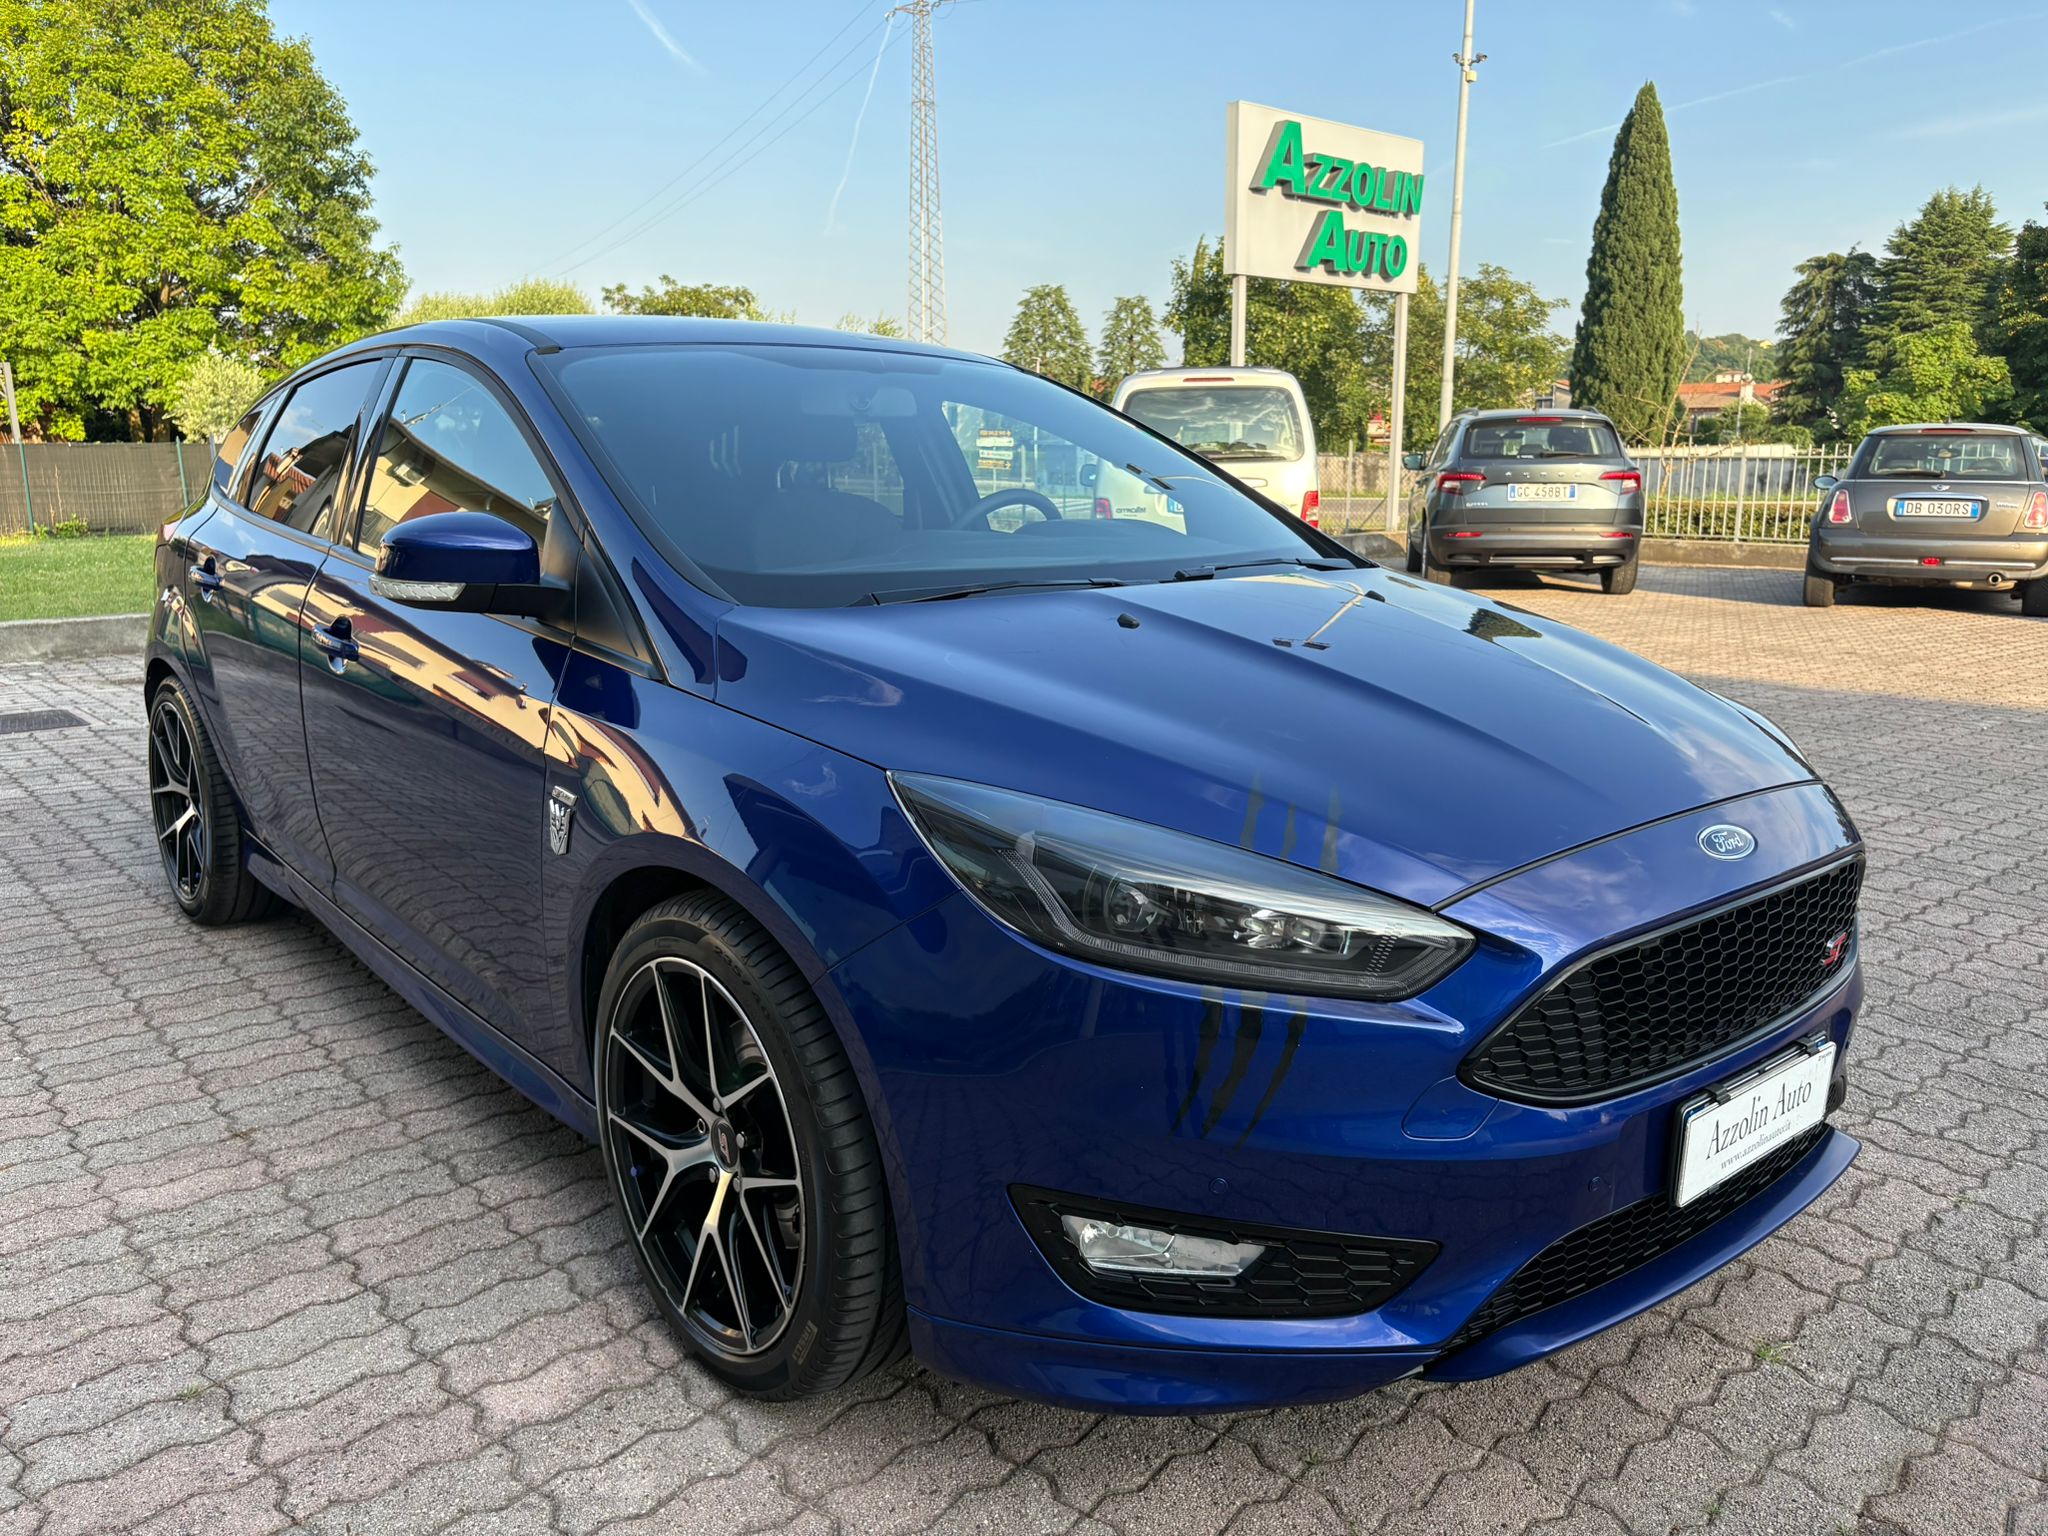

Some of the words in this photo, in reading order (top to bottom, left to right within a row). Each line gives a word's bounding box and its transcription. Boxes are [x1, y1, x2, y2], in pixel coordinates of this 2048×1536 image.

[1251, 120, 1424, 217] AZZOLIN
[1297, 210, 1408, 279] AUTO
[1711, 831, 1744, 853] Ford
[1823, 932, 1847, 967] ST
[1705, 1095, 1769, 1161] Azzolin
[1772, 1082, 1812, 1121] Auto
